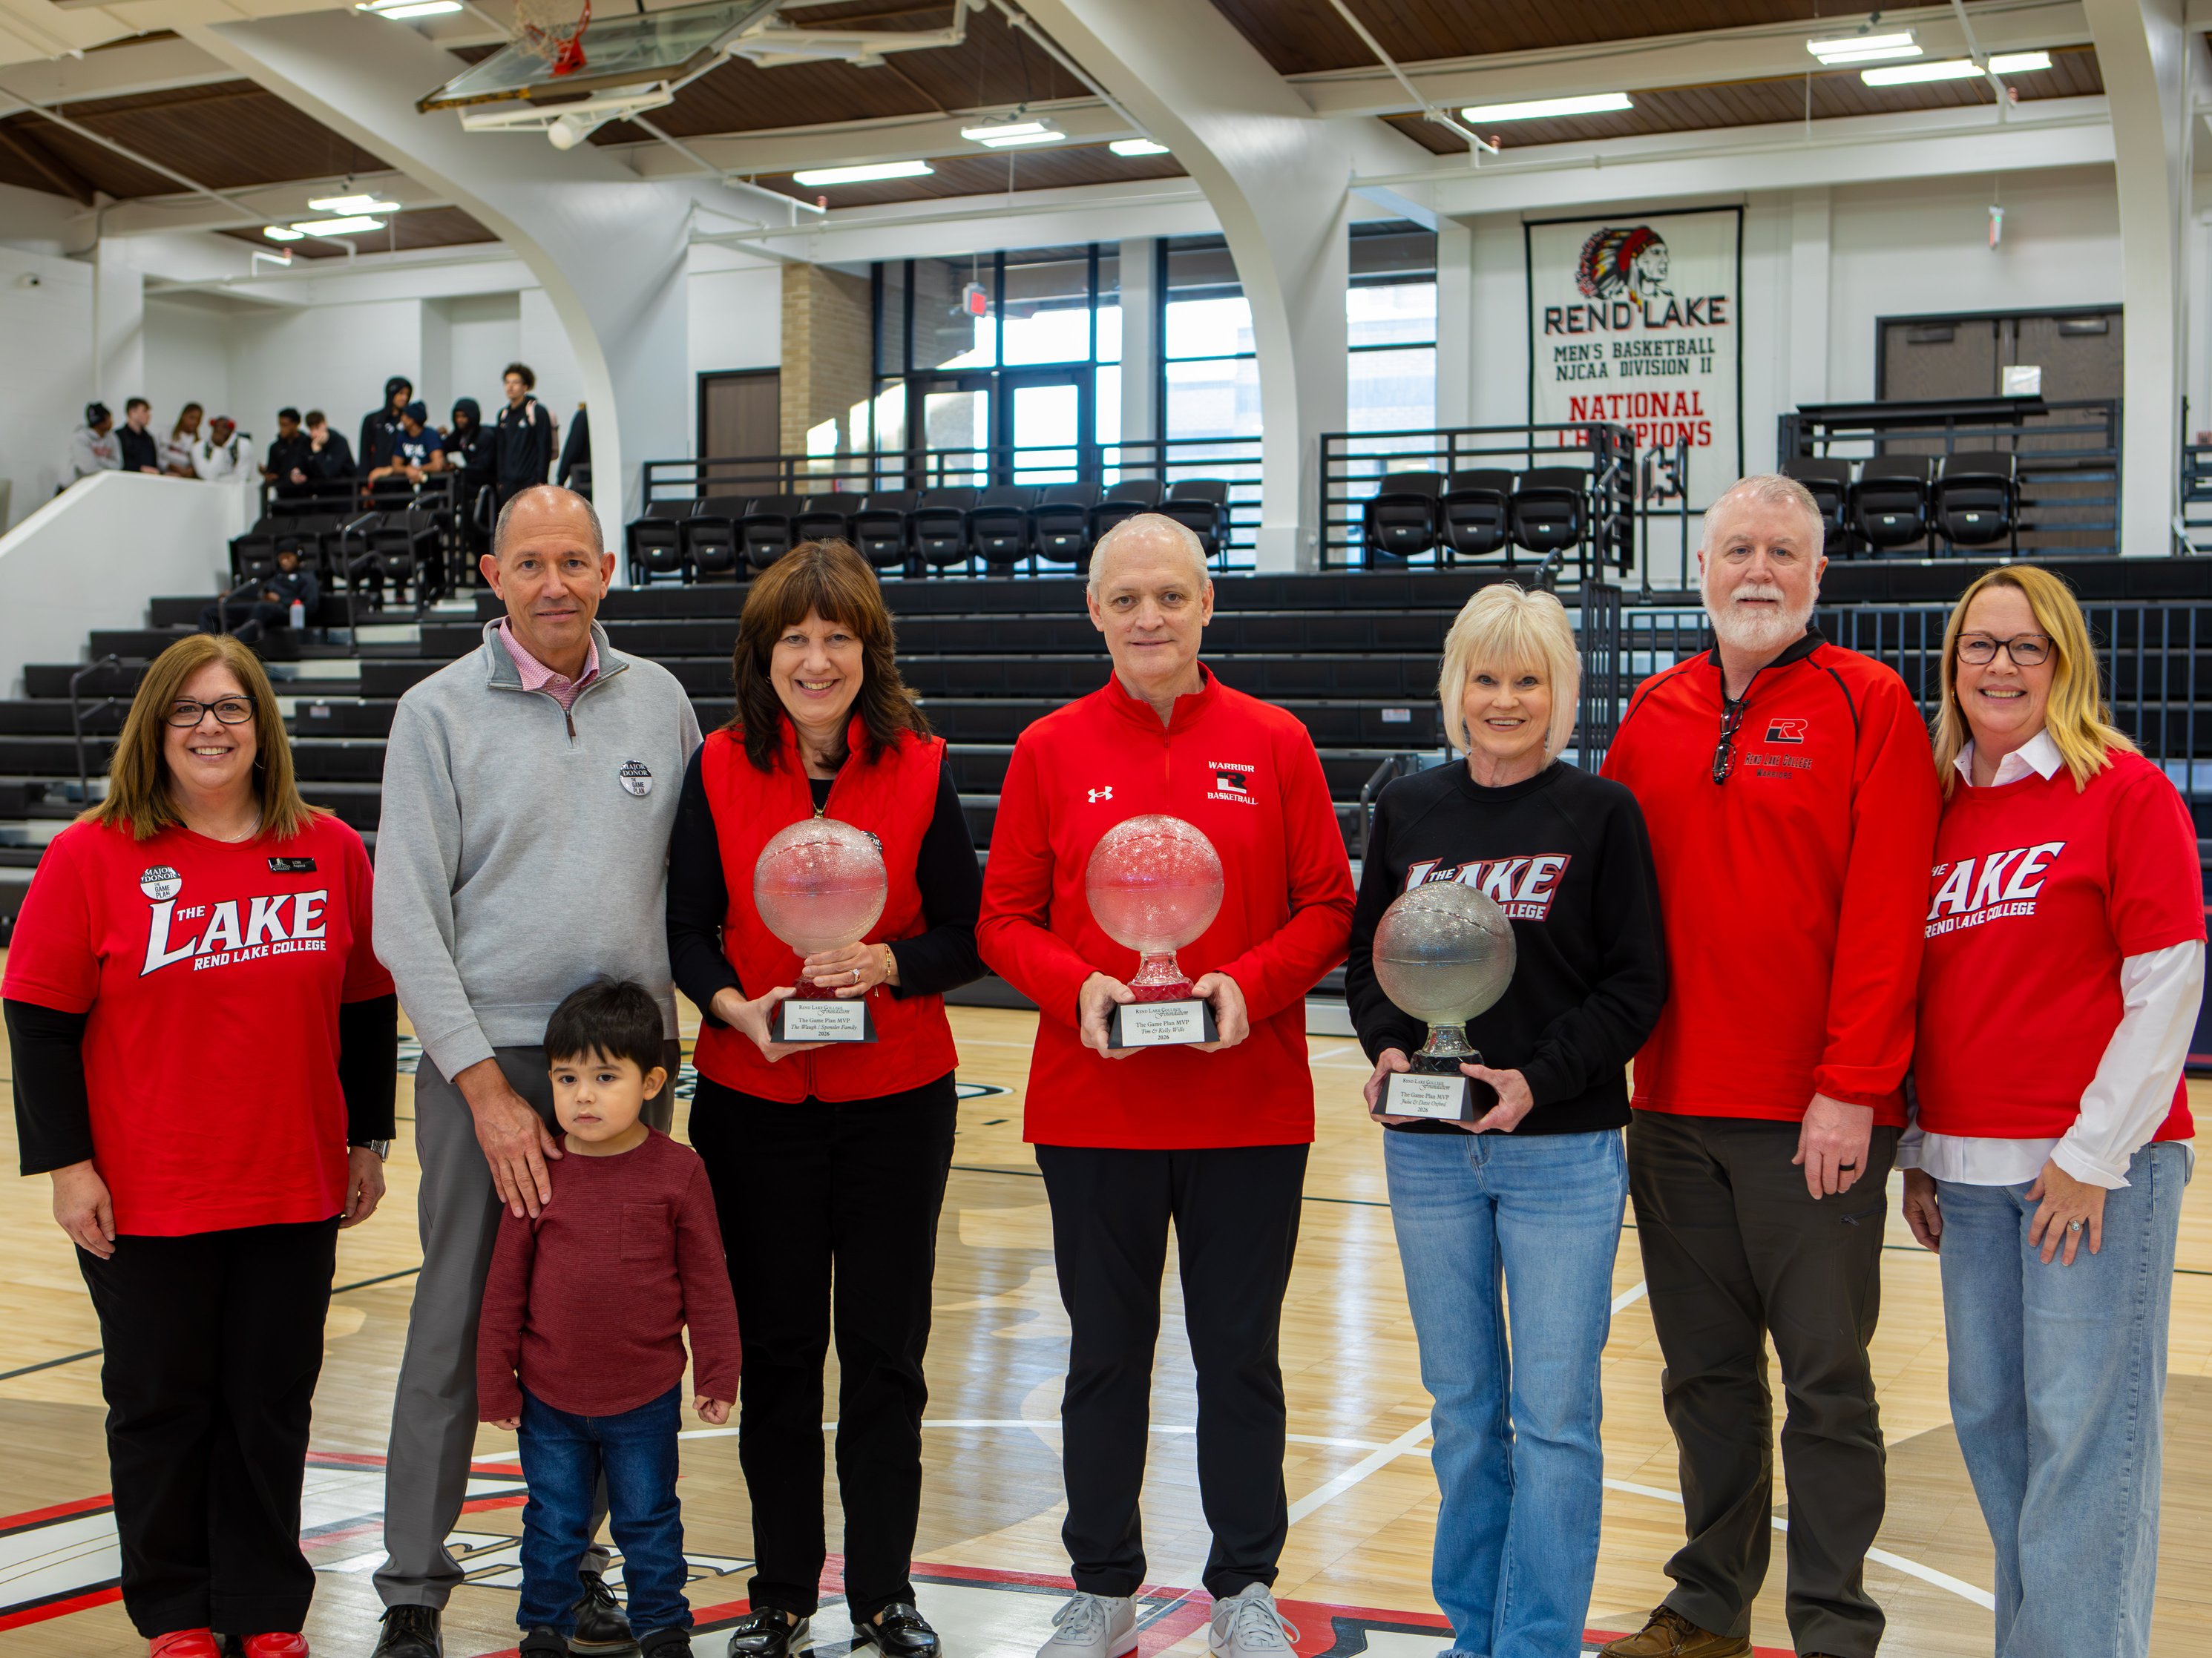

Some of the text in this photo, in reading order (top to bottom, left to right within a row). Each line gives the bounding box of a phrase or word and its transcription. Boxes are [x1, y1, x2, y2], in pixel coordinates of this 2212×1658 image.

[1544, 295, 1729, 335] REND LAKE
[1554, 338, 1716, 362] MEN'S BASKETBALL
[1555, 356, 1712, 381] NJCAA DIVISION II
[1569, 390, 1704, 421] NATIONAL
[1208, 760, 1255, 772] WARRIOR
[1745, 752, 1813, 770] REND LAKE COLLEGE
[1756, 769, 1793, 780] WARRIORS
[1207, 792, 1259, 805] BASKETBALL
[145, 867, 173, 876] MAJOR
[145, 872, 177, 882] DONOR
[1428, 868, 1456, 882] THE
[1926, 841, 2068, 921] AKE
[177, 905, 206, 921] THE
[1499, 904, 1546, 920] LLEGE
[1923, 901, 2037, 939] REND LAKE COLLEGE
[138, 889, 328, 978] LAKE
[194, 940, 326, 971] REND LAKE COLLEGE
